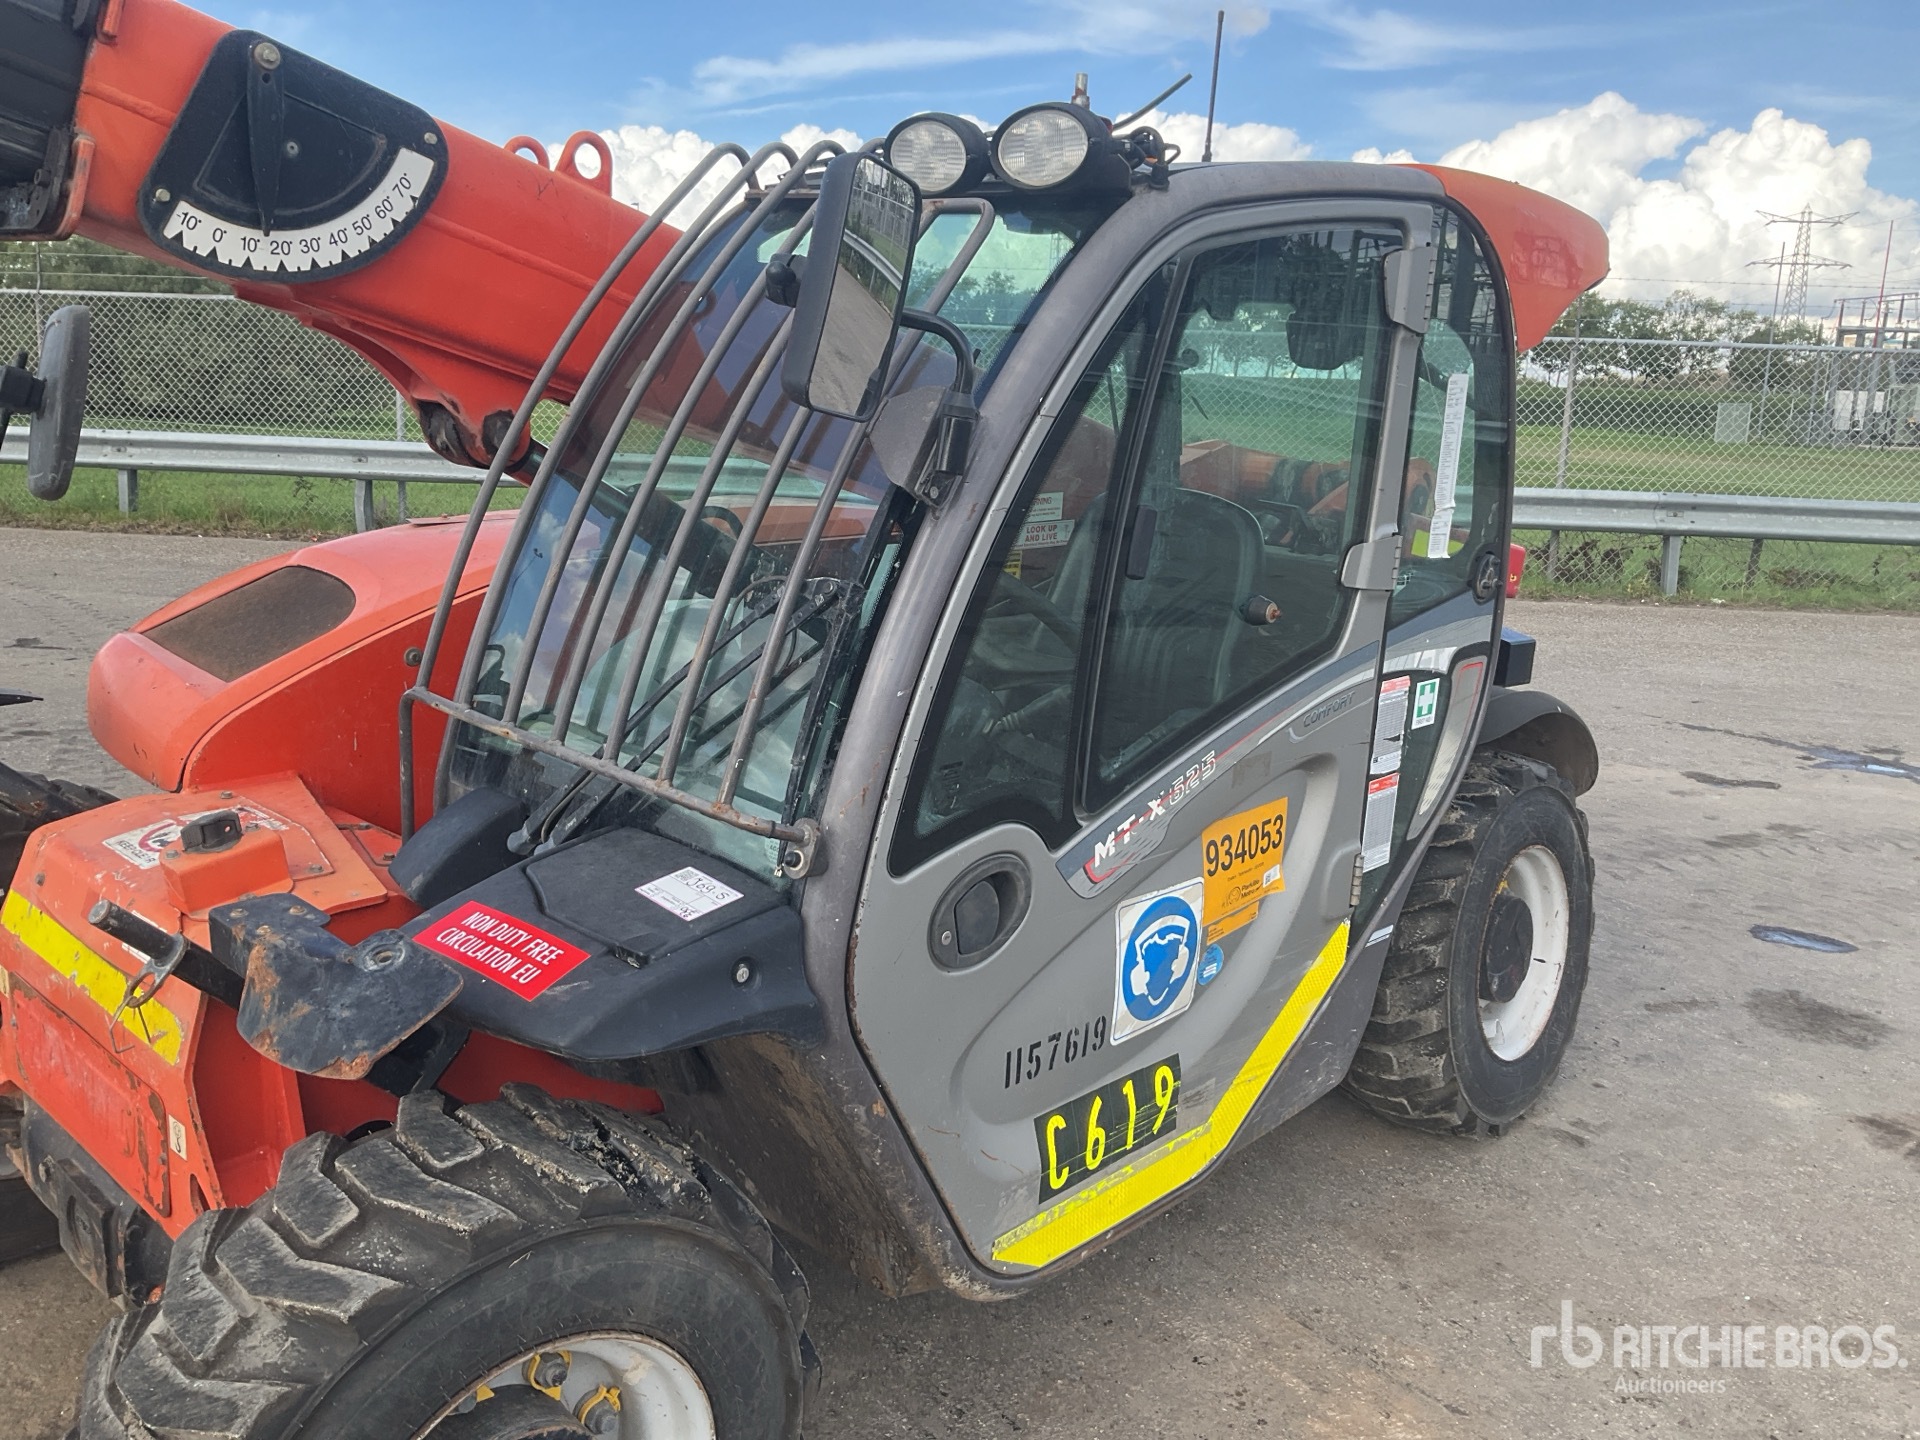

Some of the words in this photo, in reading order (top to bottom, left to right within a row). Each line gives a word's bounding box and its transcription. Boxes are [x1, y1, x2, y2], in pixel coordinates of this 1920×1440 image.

[1024, 534, 1040, 542] AND
[1041, 532, 1058, 541] LIVE
[1026, 525, 1046, 534] LOOK
[1048, 524, 1058, 532] UP
[1303, 690, 1356, 728] COMFORT
[1205, 813, 1284, 877] 934053
[436, 927, 522, 974] CIRCULATION
[510, 963, 542, 984] EU
[461, 911, 496, 933] NON
[489, 923, 533, 948] DUTY
[522, 938, 565, 966] FREE
[1004, 1015, 1107, 1089] 1157619
